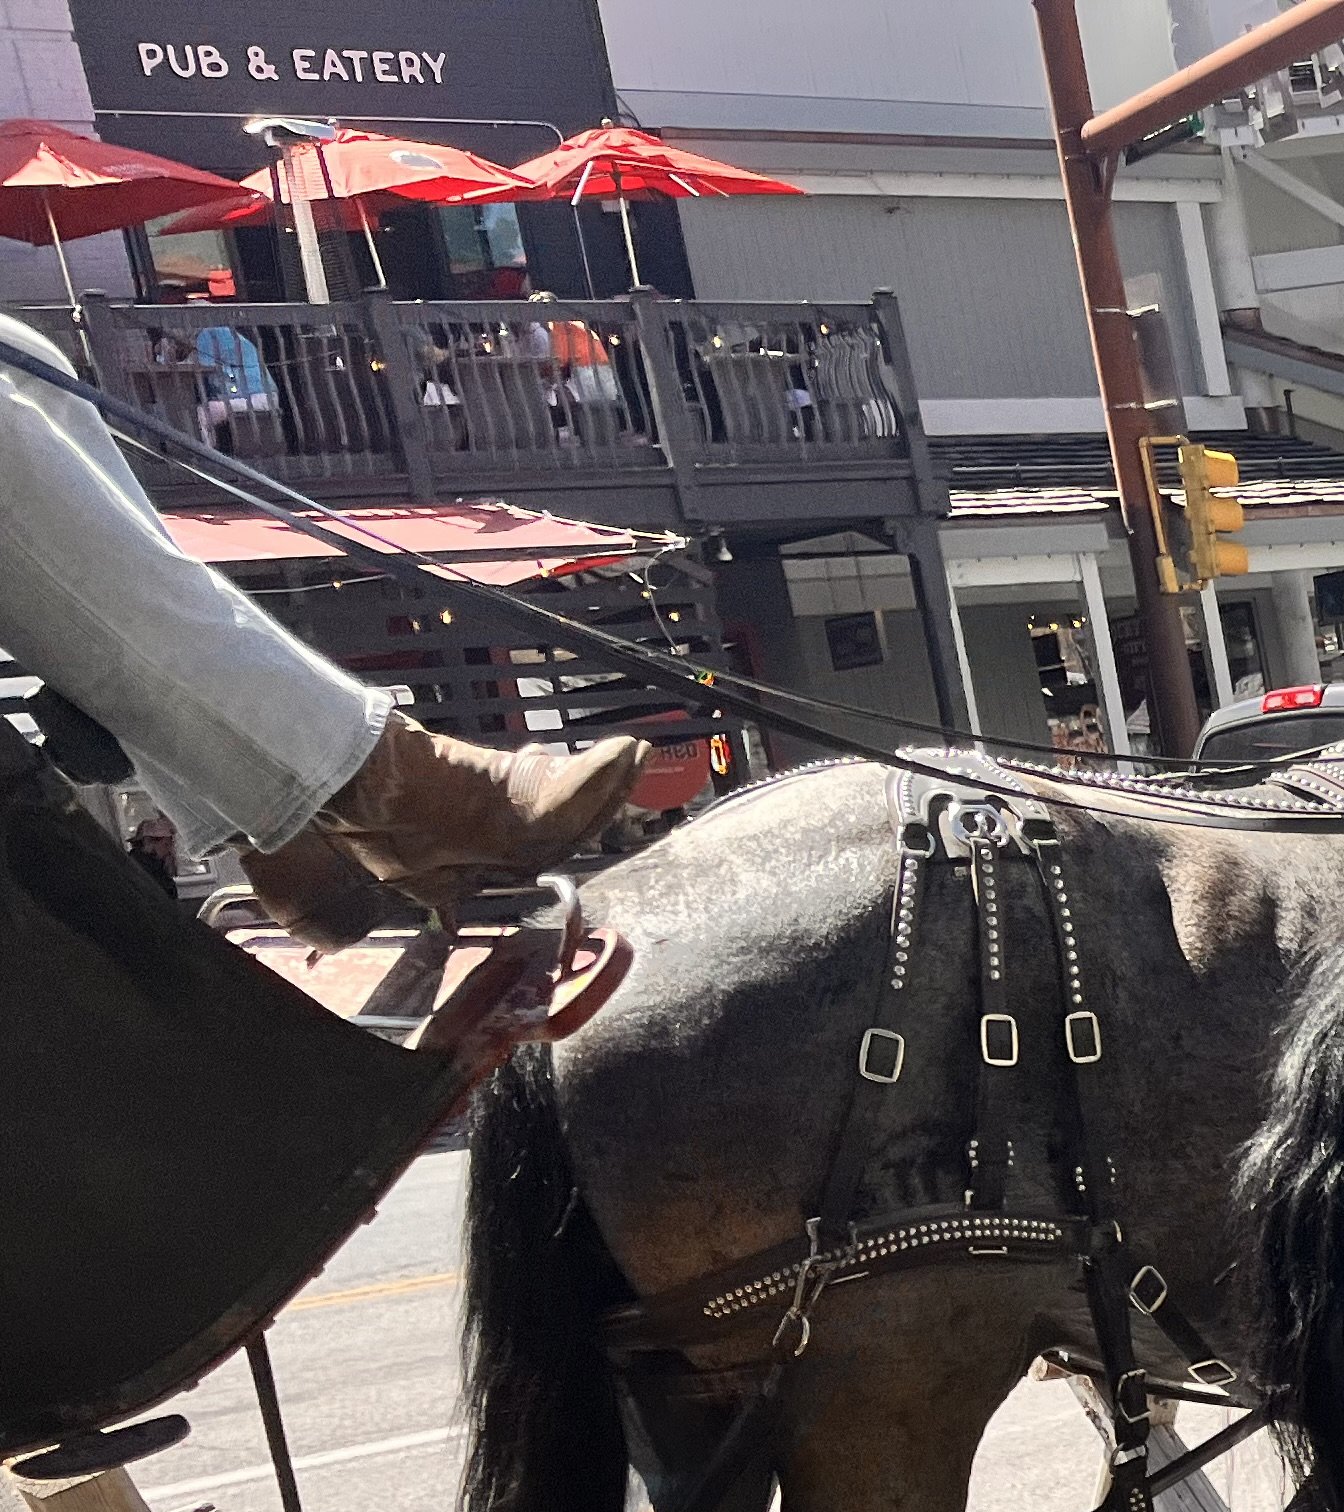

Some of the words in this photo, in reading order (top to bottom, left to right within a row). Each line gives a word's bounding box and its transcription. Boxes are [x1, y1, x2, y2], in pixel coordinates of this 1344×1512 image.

[138, 42, 229, 78] PUB
[246, 45, 280, 81] &
[292, 48, 446, 84] EATERY
